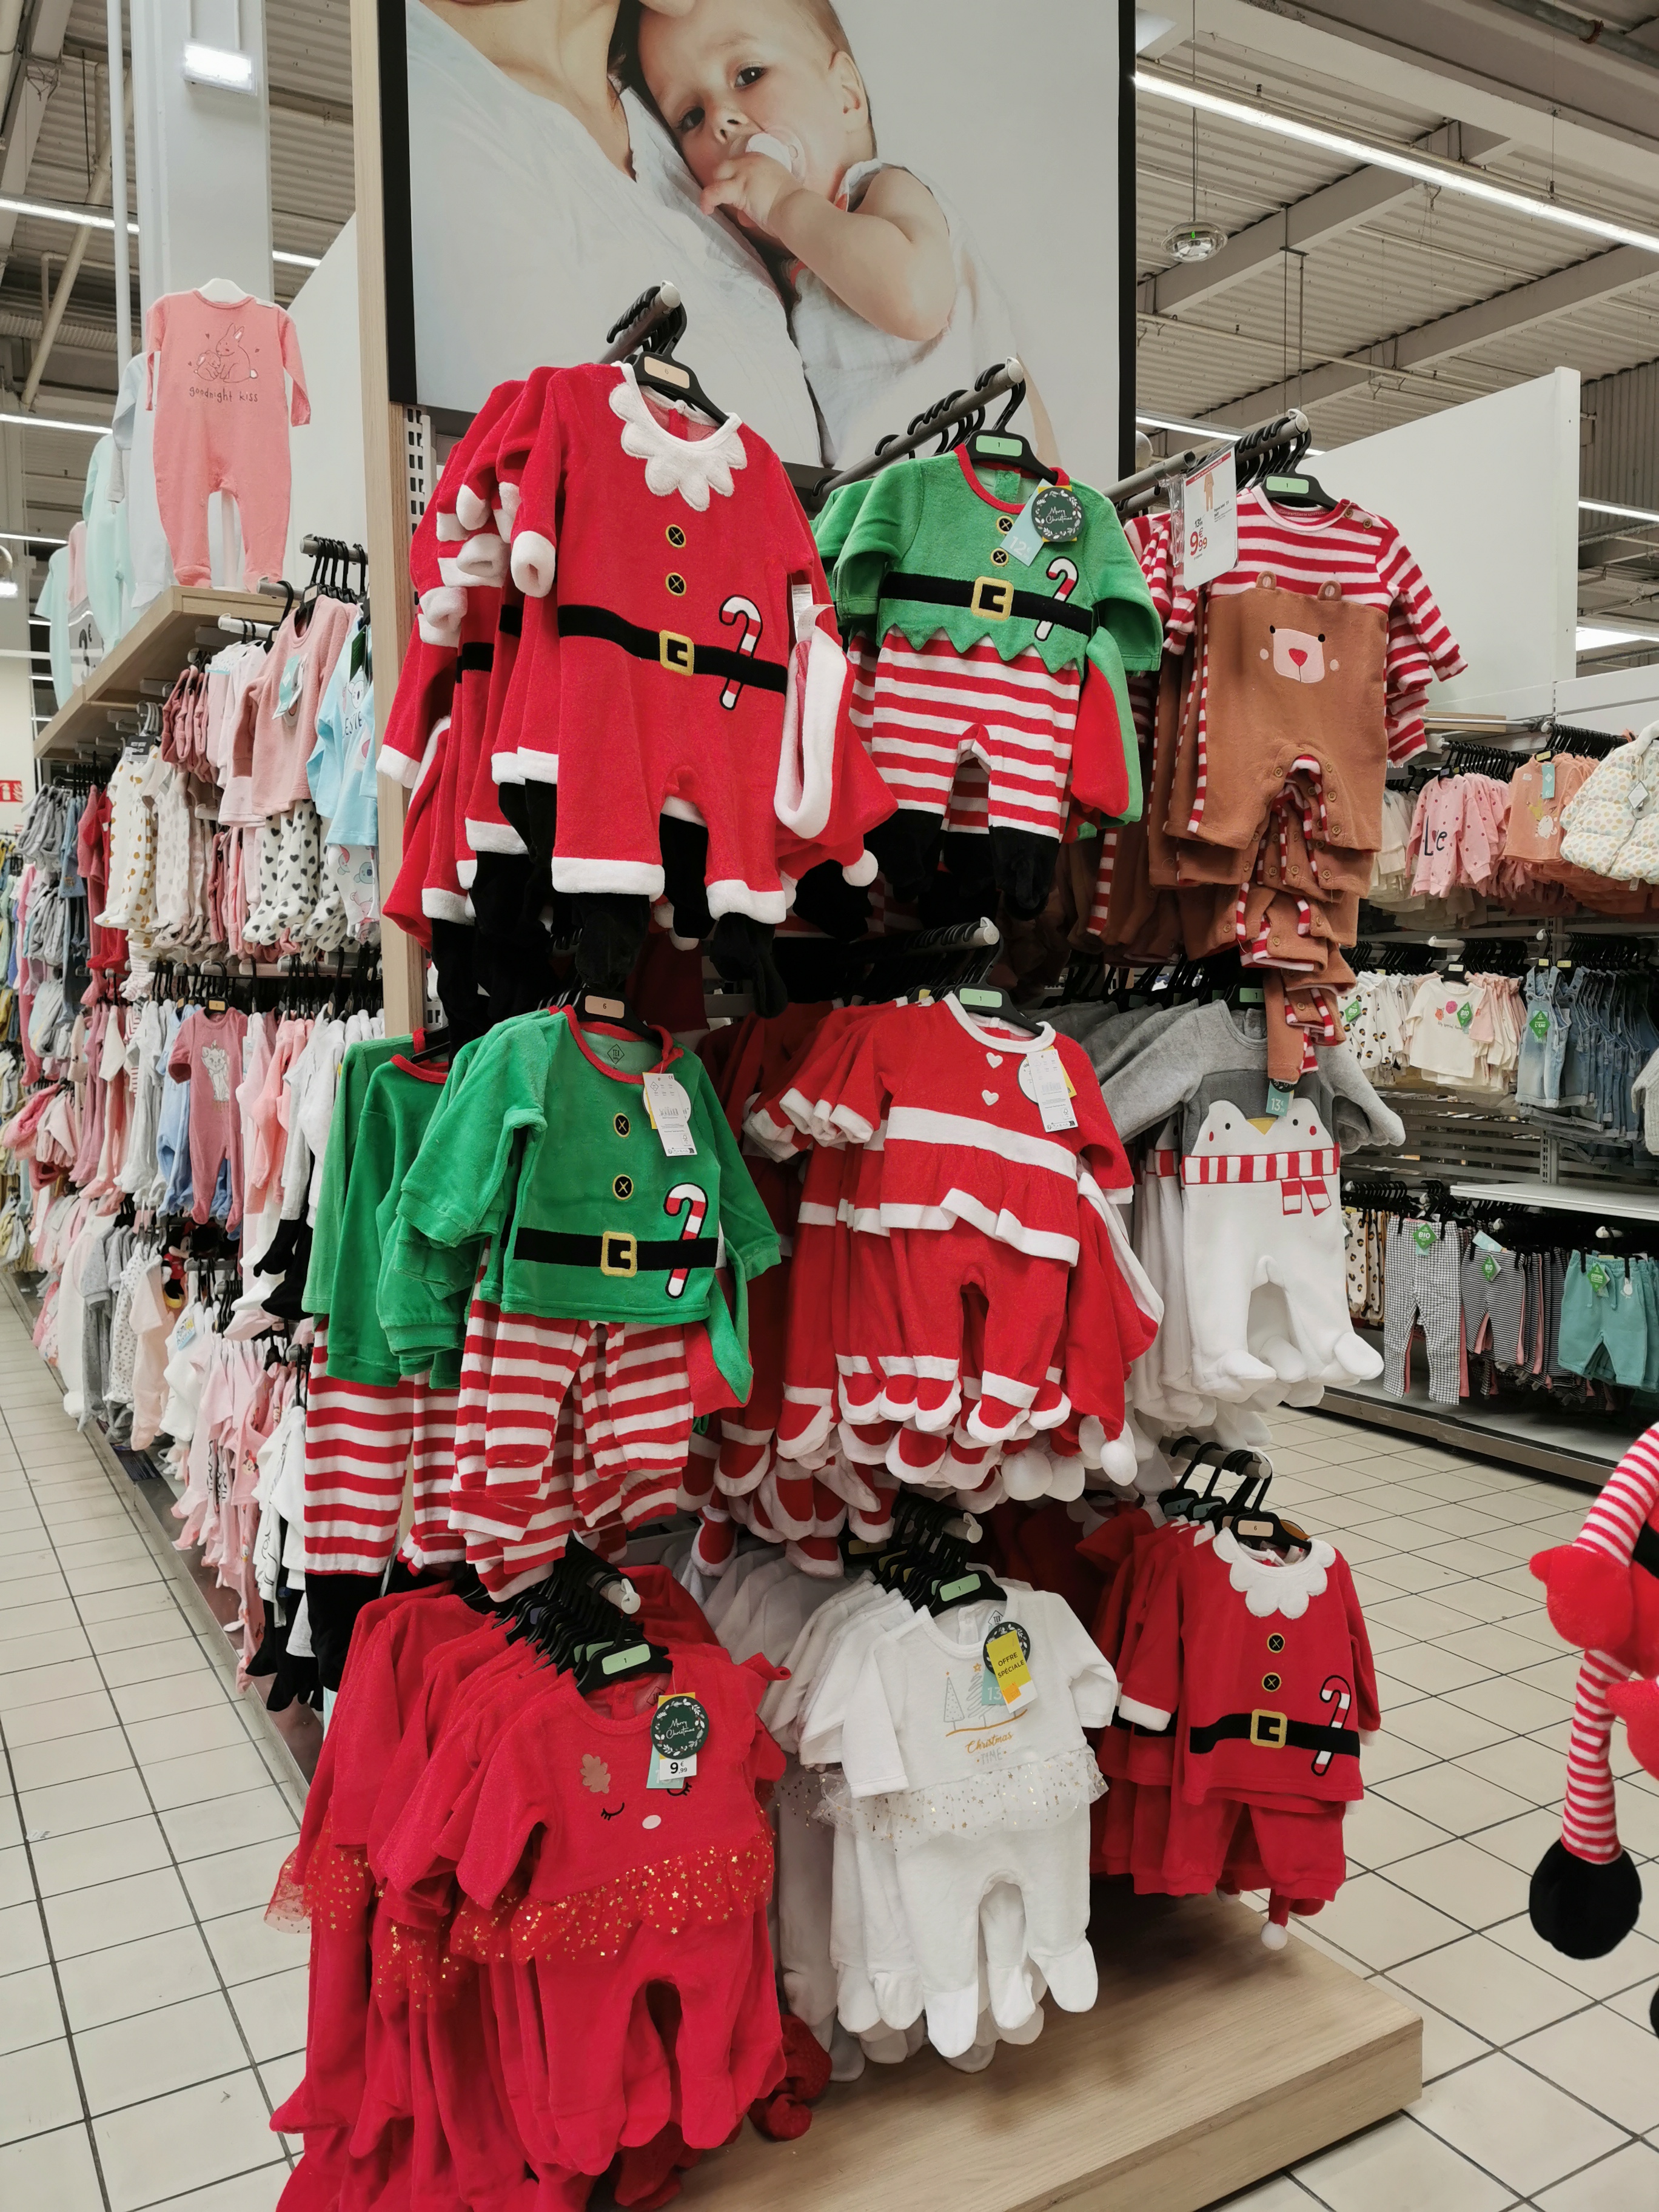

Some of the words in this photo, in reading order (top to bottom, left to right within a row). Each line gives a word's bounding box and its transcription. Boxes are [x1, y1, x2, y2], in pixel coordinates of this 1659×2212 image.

[189, 387, 232, 403] goodnight
[240, 391, 258, 402] kiss
[1048, 506, 1066, 516] Merry
[1046, 514, 1073, 524] Christmas
[998, 1652, 1018, 1667] OFFRE
[997, 1660, 1025, 1678] SPÉCIALE
[668, 1718, 688, 1729] Merry
[666, 1726, 695, 1739] Christmas
[965, 1731, 1014, 1754] Christmas
[980, 1747, 1003, 1765] TIME
